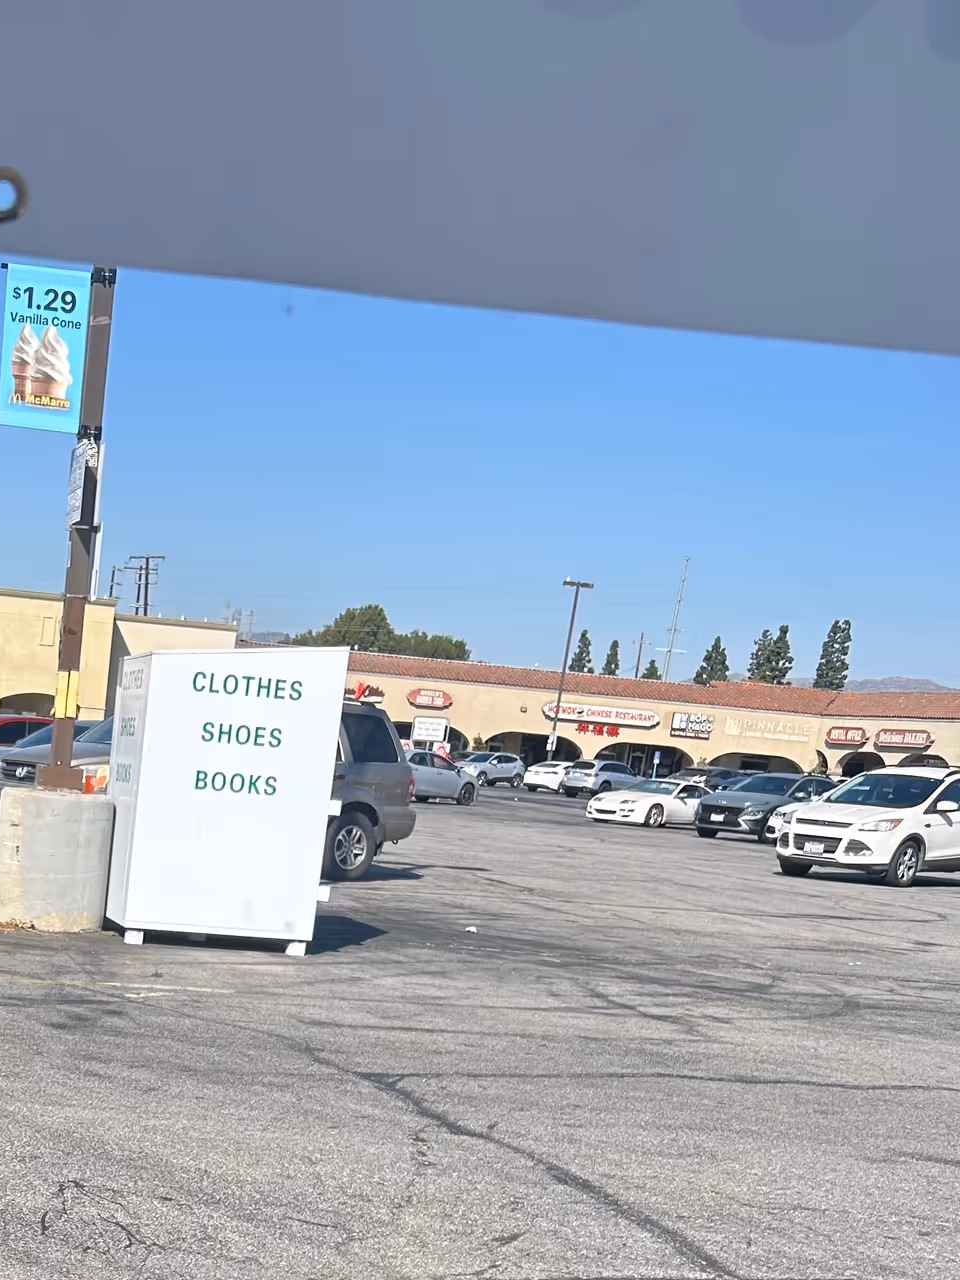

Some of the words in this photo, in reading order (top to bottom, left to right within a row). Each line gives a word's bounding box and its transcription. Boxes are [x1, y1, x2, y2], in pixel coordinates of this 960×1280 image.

[12, 286, 77, 314] $1.29
[10, 312, 49, 327] Vanilla
[51, 316, 82, 330] Cone
[122, 668, 144, 691] CLOTHES
[192, 671, 304, 702] CLOTHES
[586, 708, 613, 719] CHINESE
[615, 711, 656, 722] RESTAURANT
[201, 721, 283, 750] SHOES
[879, 732, 904, 743] Delicious
[904, 733, 928, 744] BAKERY
[195, 770, 278, 797] BOOKS
